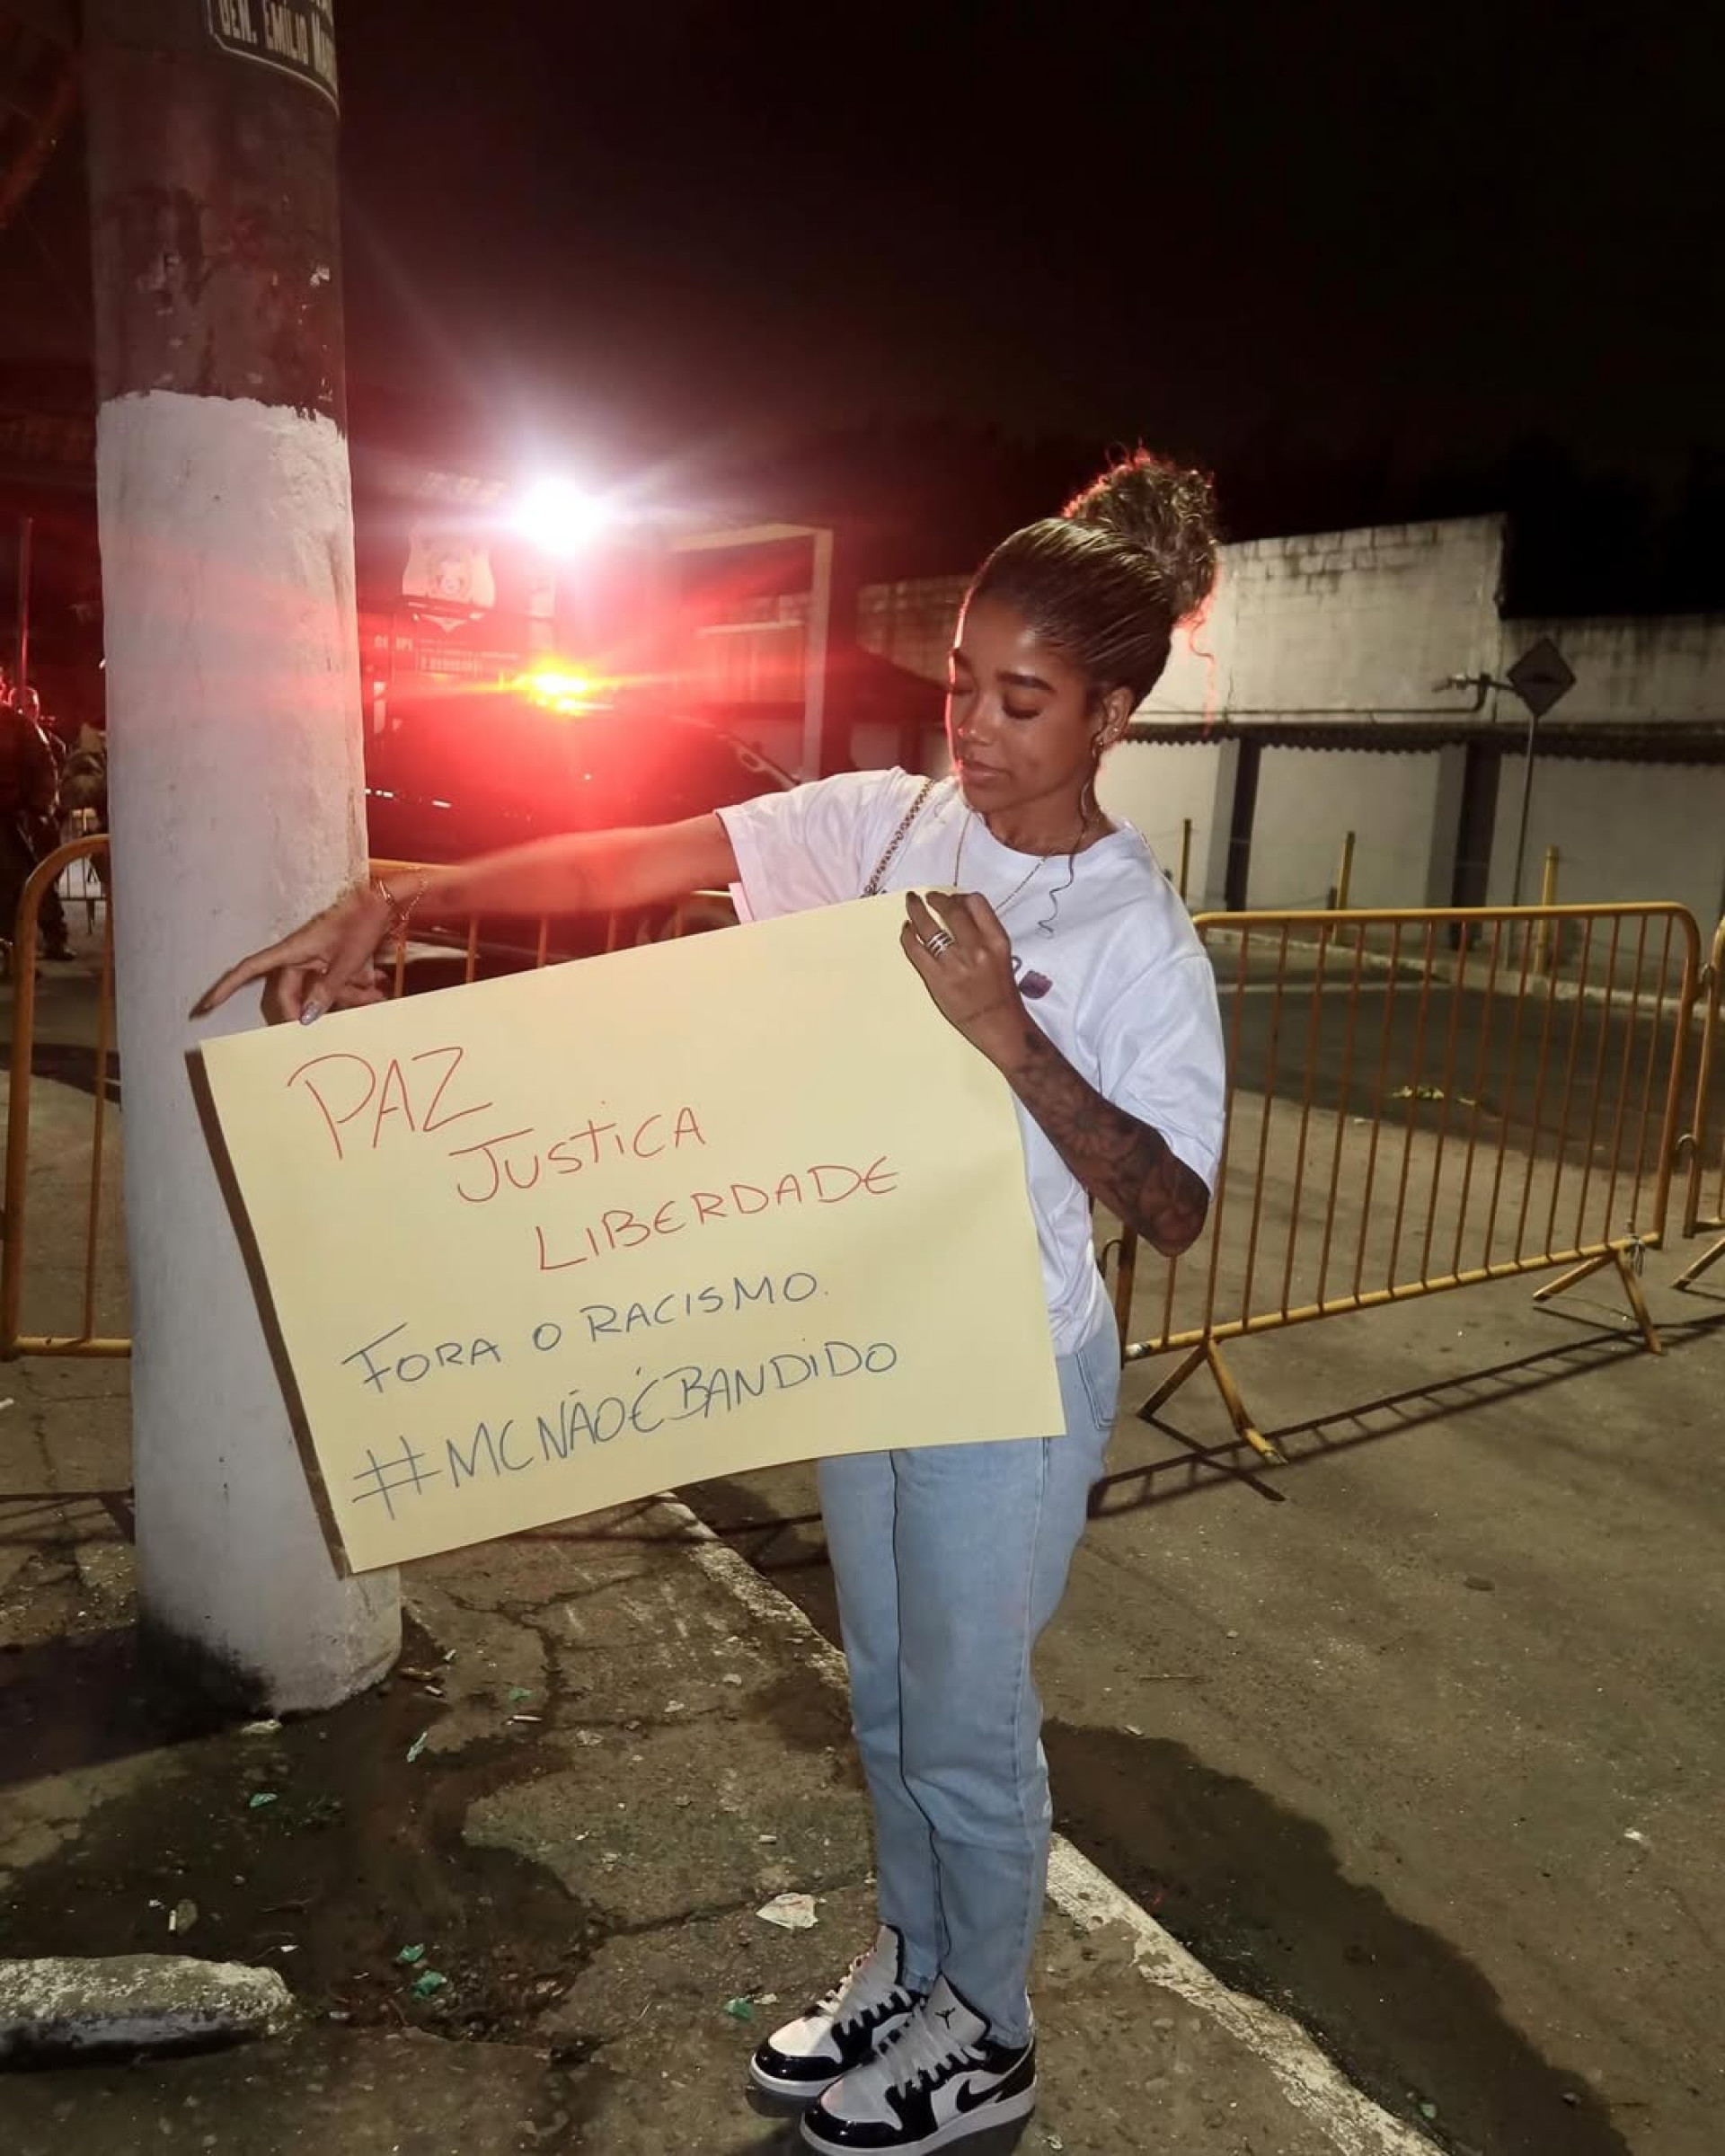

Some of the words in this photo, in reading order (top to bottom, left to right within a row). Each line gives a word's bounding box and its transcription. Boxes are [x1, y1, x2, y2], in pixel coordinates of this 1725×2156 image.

[287, 1046, 493, 1161] PAZ
[535, 1155, 899, 1273] LIBERDADE
[341, 1321, 502, 1393] FORA
[531, 1321, 563, 1353] O
